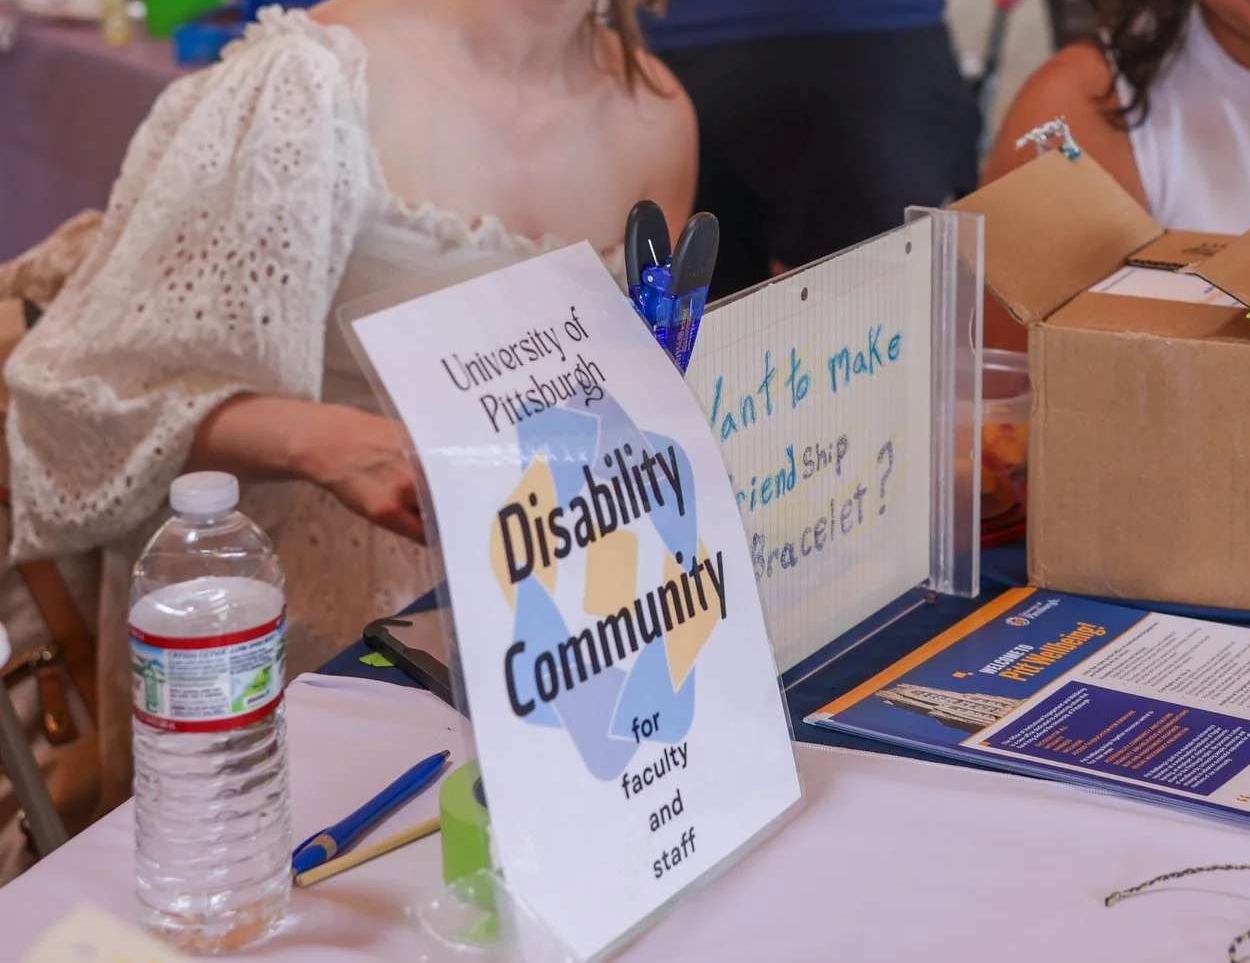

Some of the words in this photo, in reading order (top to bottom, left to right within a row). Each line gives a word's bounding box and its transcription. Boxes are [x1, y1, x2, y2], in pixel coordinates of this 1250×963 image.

[441, 327, 566, 391] University
[564, 306, 589, 342] of
[479, 354, 606, 433] Pittsburgh
[711, 350, 776, 442] ant
[786, 347, 813, 409] to
[498, 443, 686, 585] Disability
[504, 551, 728, 717] Community
[979, 646, 1024, 675] WELCOME
[1018, 644, 1035, 656] TO
[1021, 621, 1106, 666] Wellbeing!
[998, 661, 1046, 682] Pitt
[631, 712, 660, 743] for
[621, 742, 688, 799] faculty
[650, 789, 684, 832] and
[653, 827, 696, 879] staff
